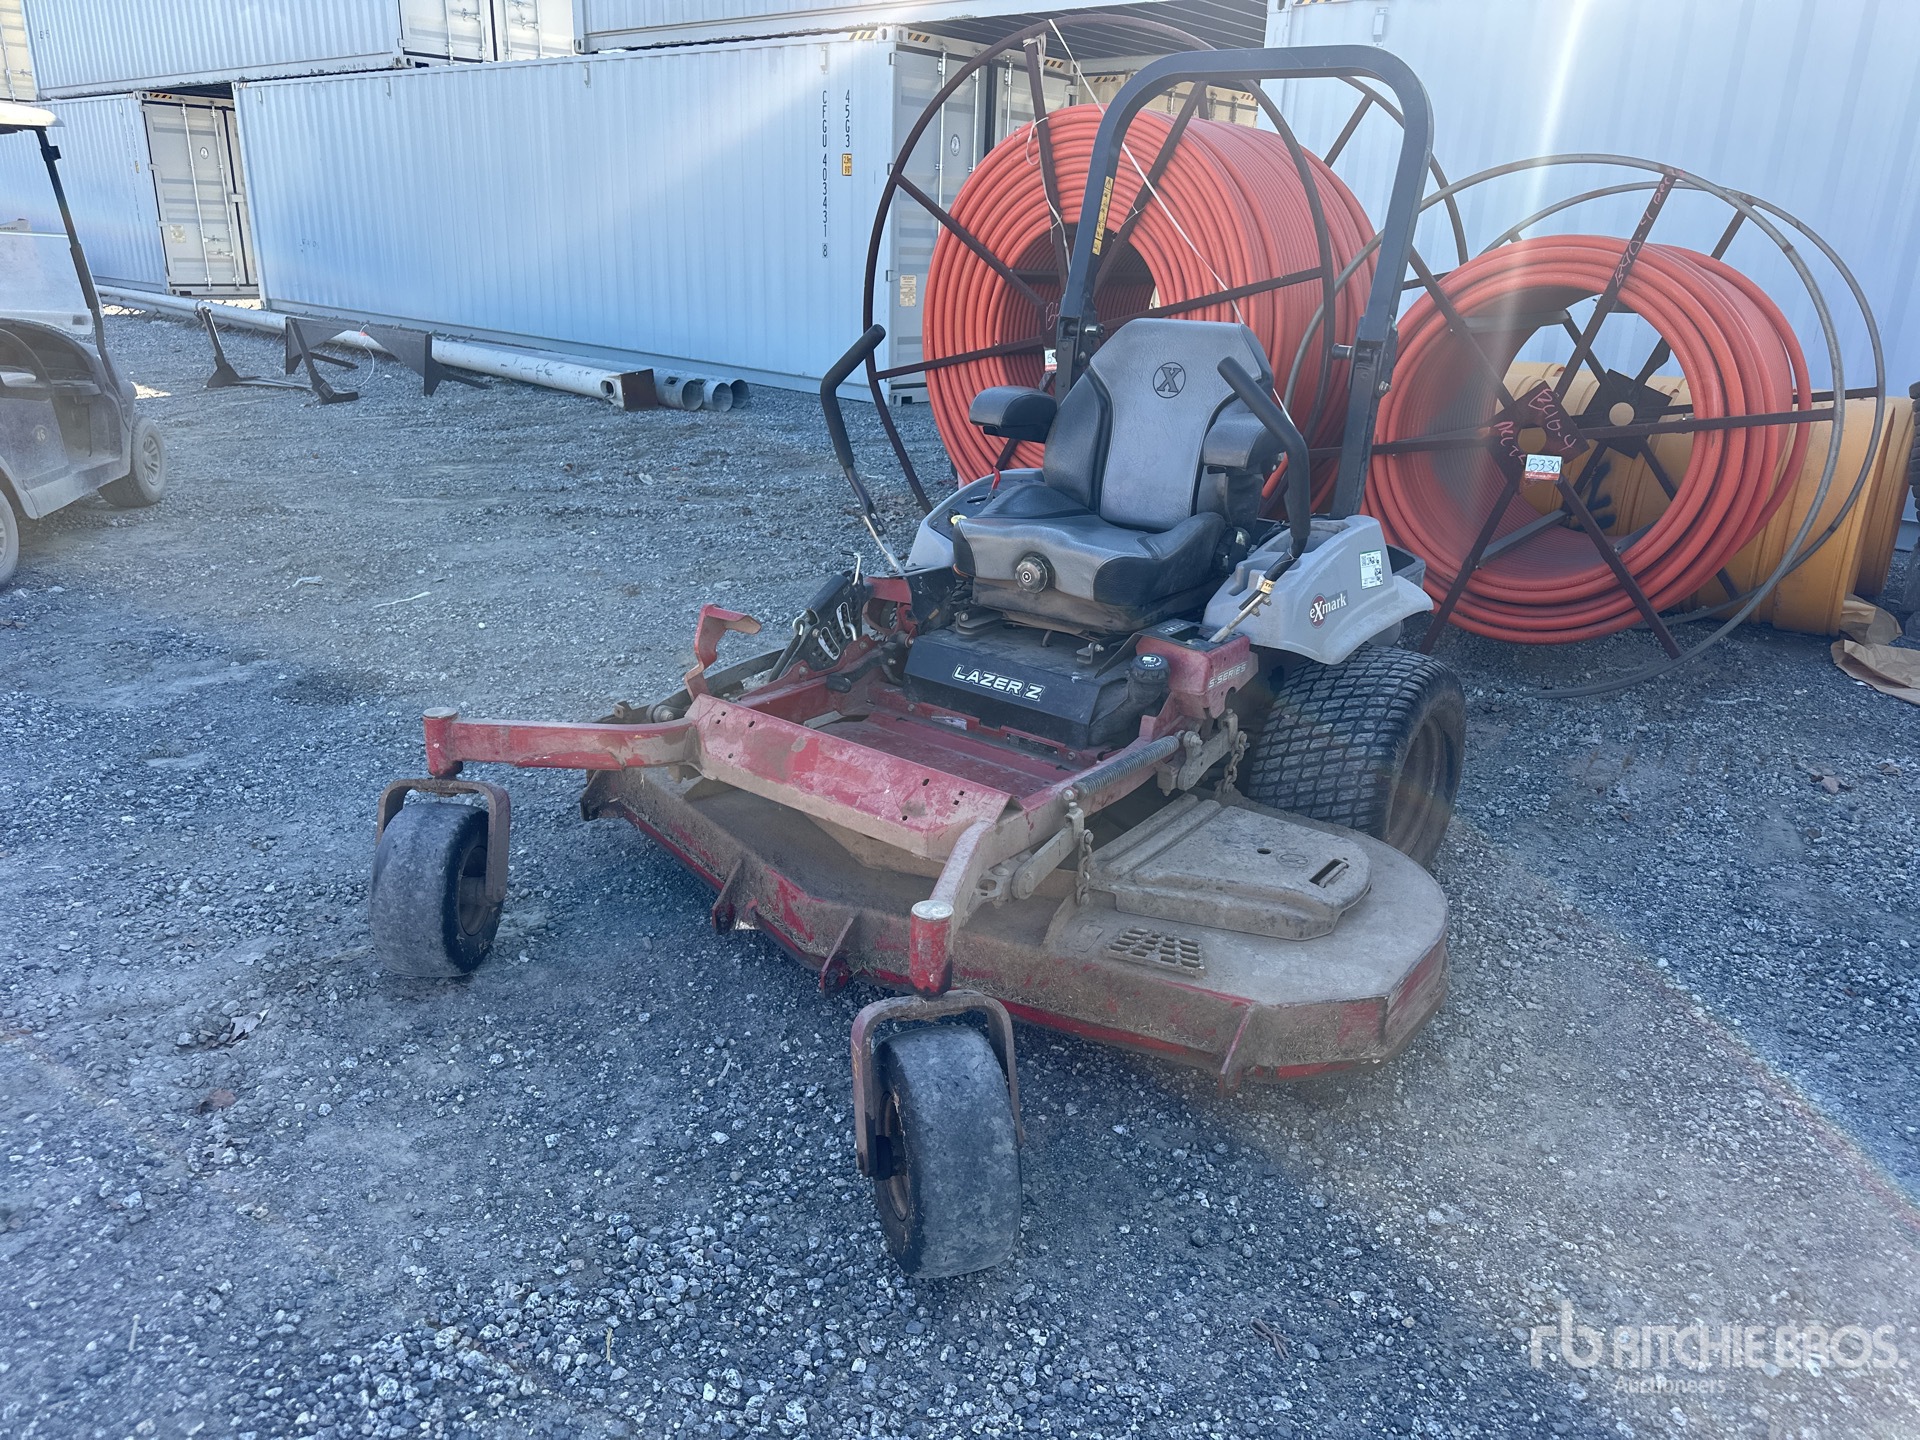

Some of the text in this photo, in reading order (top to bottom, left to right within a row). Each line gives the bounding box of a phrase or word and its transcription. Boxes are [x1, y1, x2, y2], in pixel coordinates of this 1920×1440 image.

[822, 243, 828, 258] 8
[1528, 457, 1560, 473] 5330
[1309, 593, 1347, 623] eXmark
[953, 665, 1044, 701] LAZER Z
[1208, 663, 1247, 688] S-SERIES
